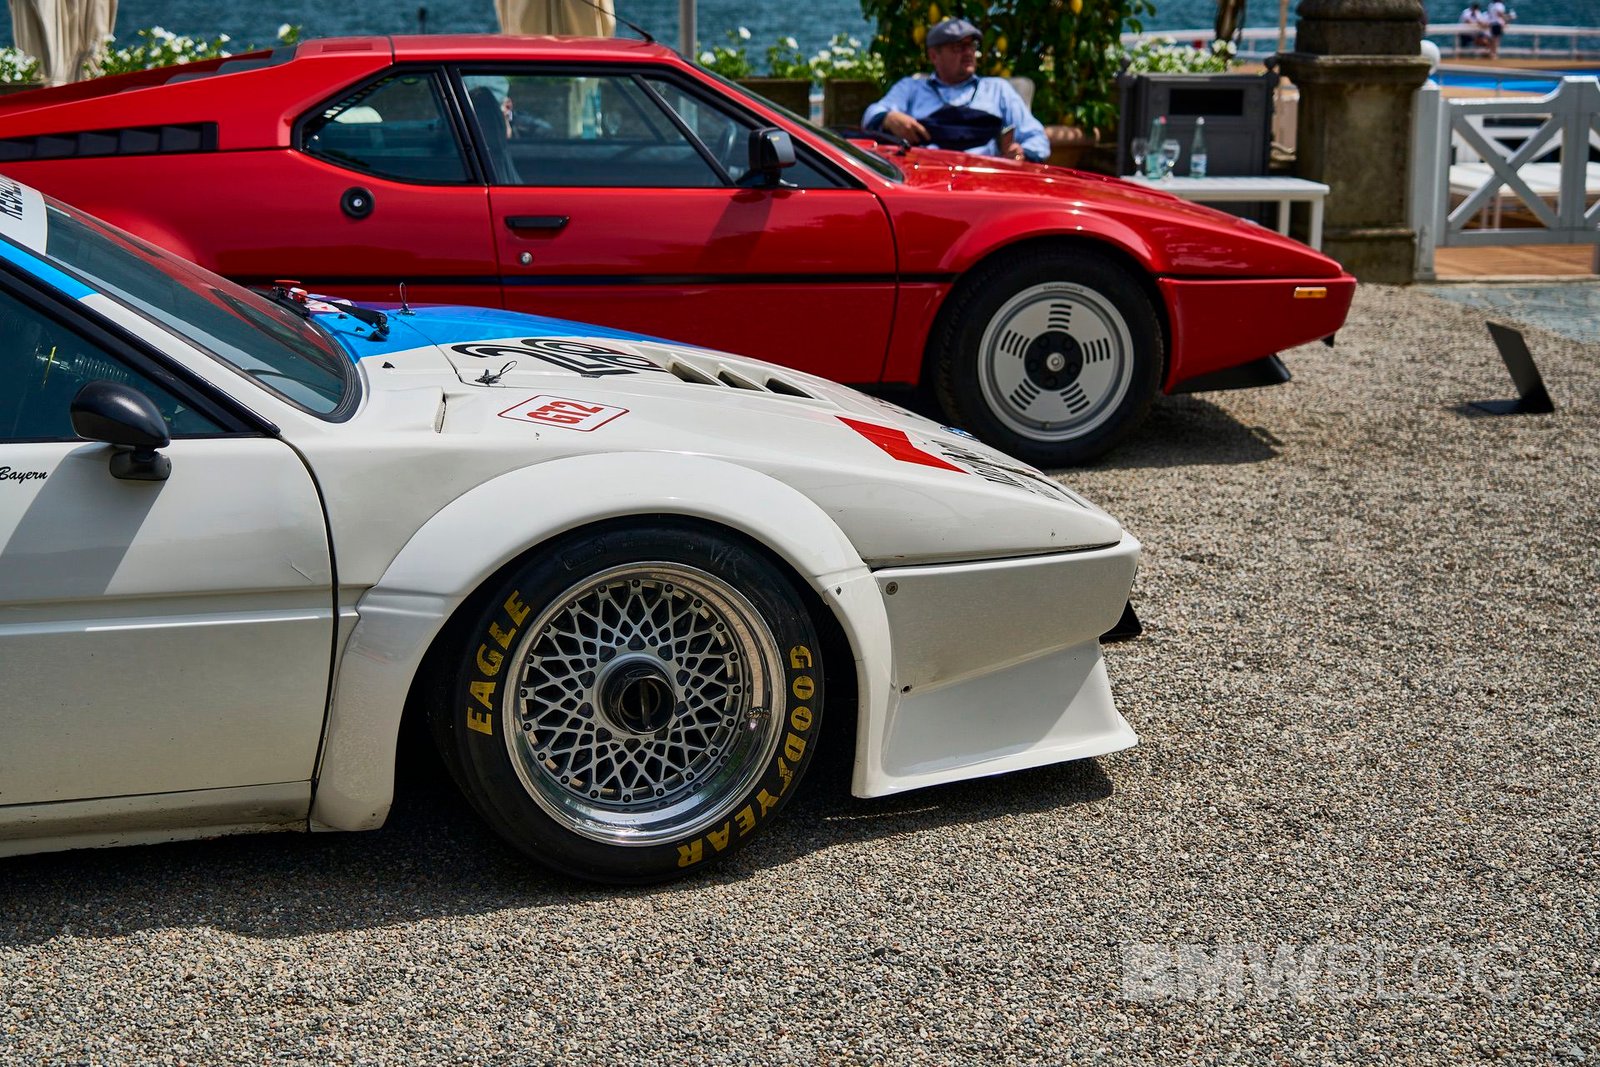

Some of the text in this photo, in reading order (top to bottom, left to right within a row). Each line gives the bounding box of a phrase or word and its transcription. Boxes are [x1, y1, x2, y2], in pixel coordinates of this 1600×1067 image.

[526, 400, 605, 425] GT2
[0, 466, 48, 484] Bayern
[467, 590, 531, 736] EAGLE
[677, 645, 816, 868] GOODYEAR
